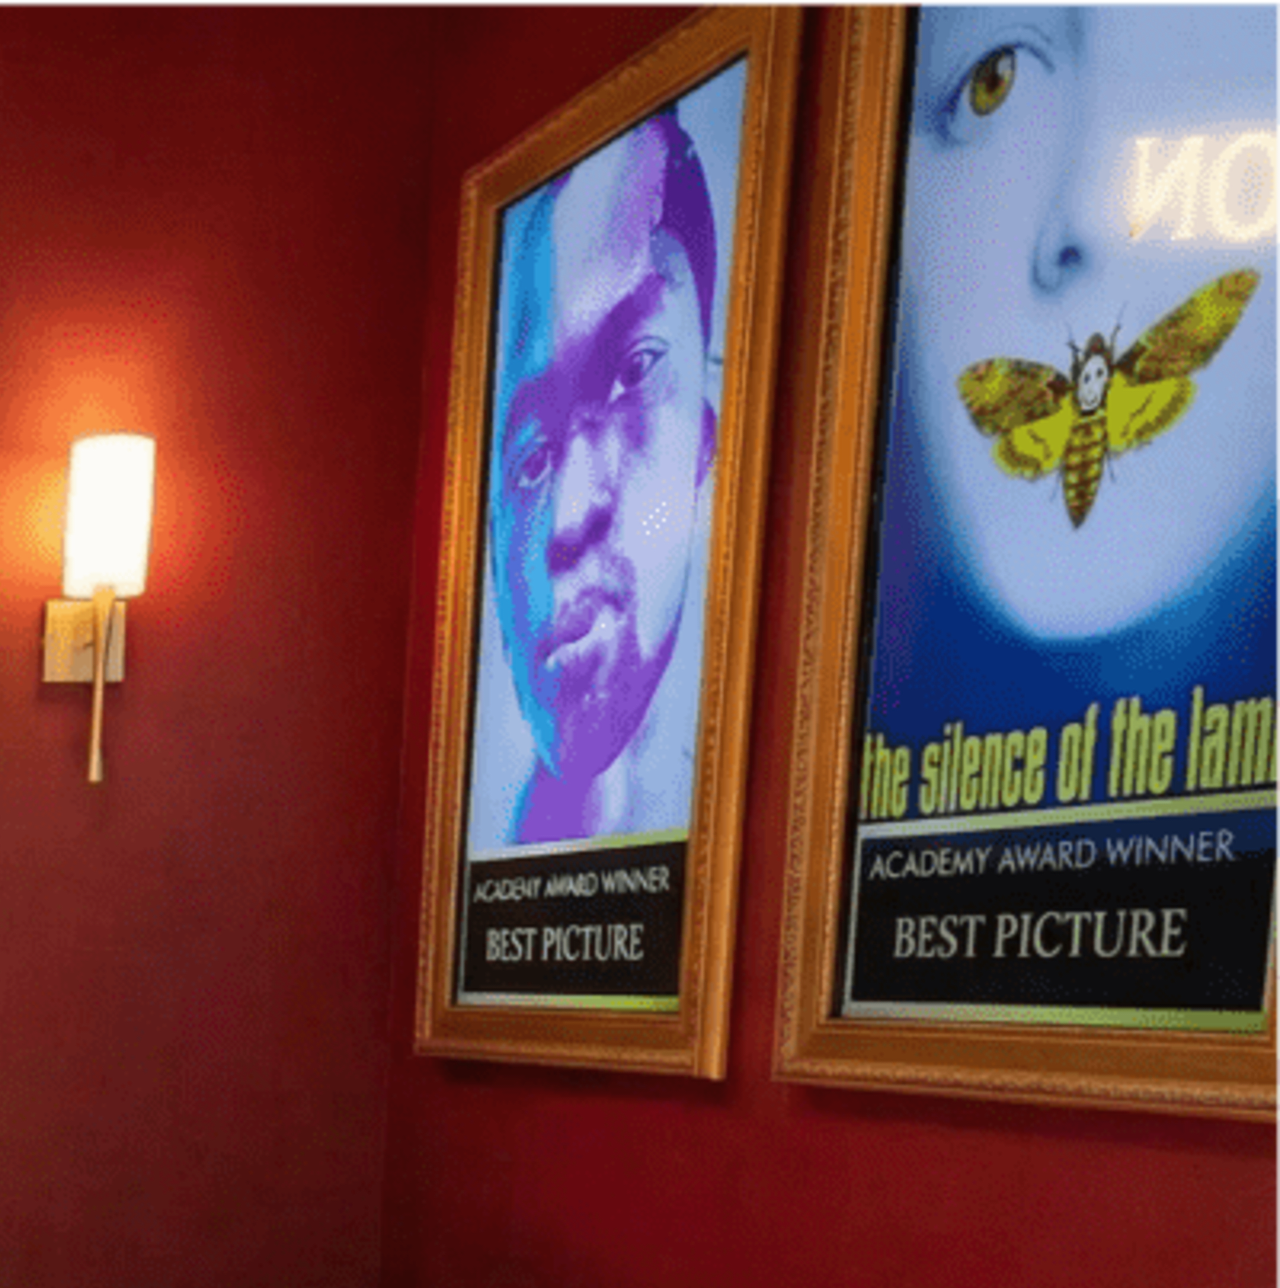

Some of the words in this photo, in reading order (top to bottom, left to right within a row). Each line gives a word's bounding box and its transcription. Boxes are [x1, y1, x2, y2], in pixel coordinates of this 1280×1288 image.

[860, 731, 911, 820] the
[919, 721, 1048, 815] silence
[1057, 702, 1098, 803] of
[1108, 696, 1176, 797] the
[1186, 684, 1278, 791] lam
[869, 848, 991, 879] ACADEMY
[997, 839, 1097, 872] AWARD
[1106, 828, 1236, 864] WINNER
[473, 877, 541, 903] ACADEMY
[543, 872, 598, 899] AWARD
[601, 865, 670, 893] WINNER
[485, 926, 538, 962] BEST
[539, 922, 645, 962] PICTURE
[894, 914, 986, 958] BEST
[992, 908, 1188, 958] PICTURE
